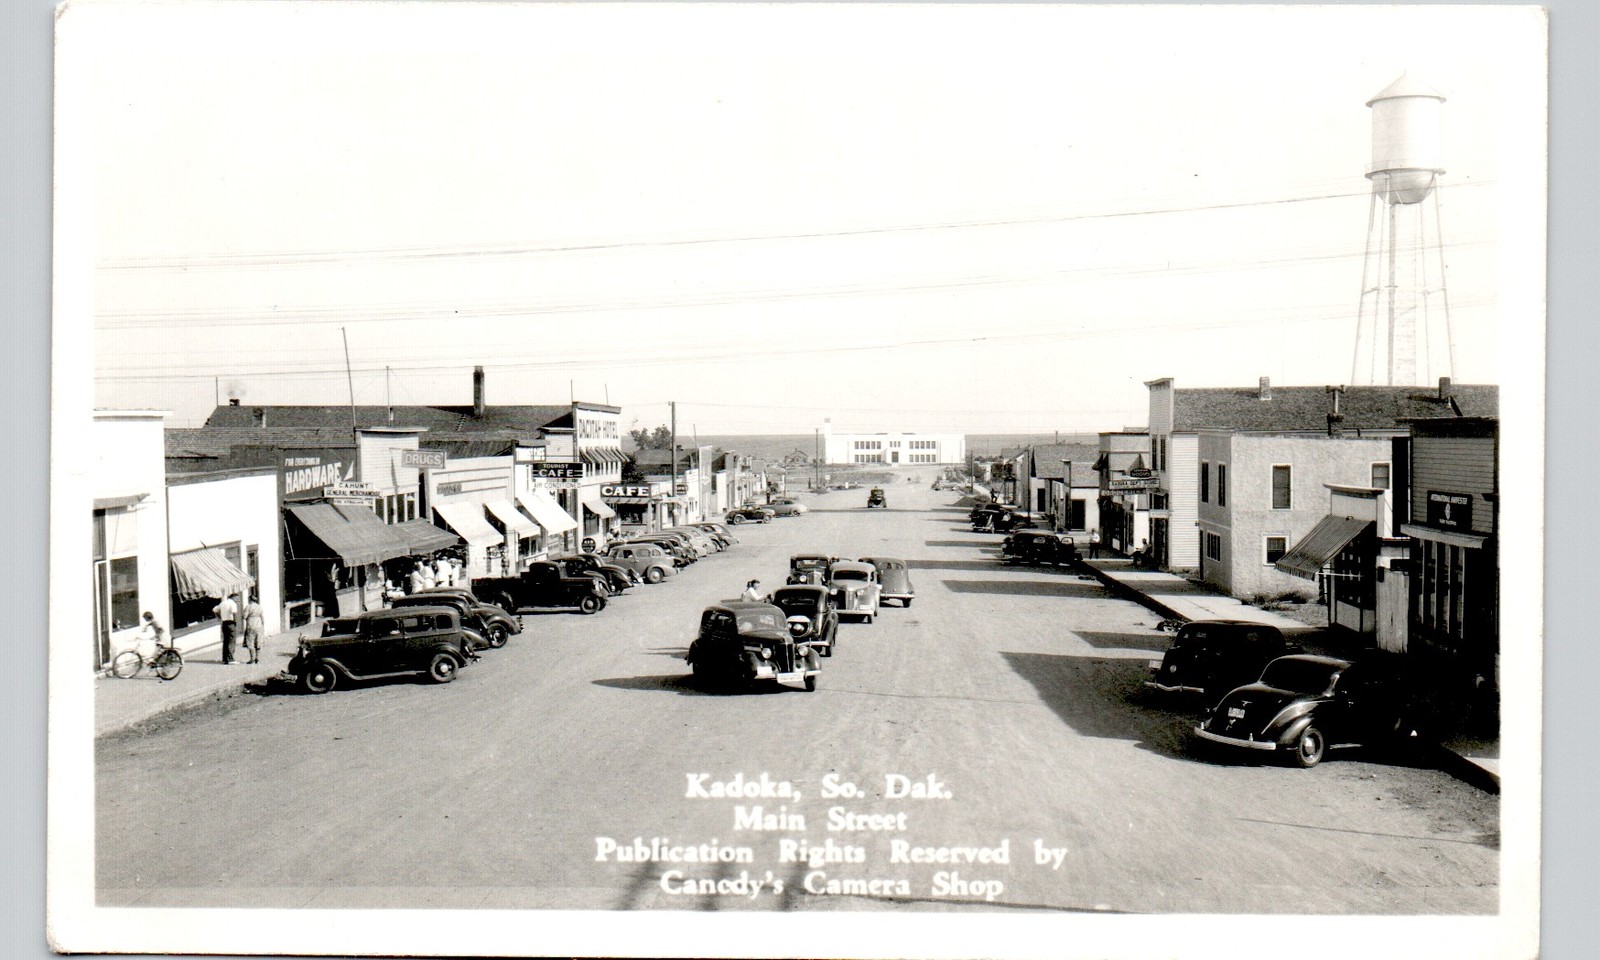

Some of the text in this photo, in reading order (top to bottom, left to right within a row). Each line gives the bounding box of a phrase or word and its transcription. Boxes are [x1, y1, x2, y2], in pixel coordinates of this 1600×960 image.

[405, 453, 442, 466] DRUGS
[285, 461, 342, 495] HARDWARE
[538, 469, 574, 477] CAFE
[326, 489, 348, 497] GENERAL
[600, 485, 650, 497] CAFE
